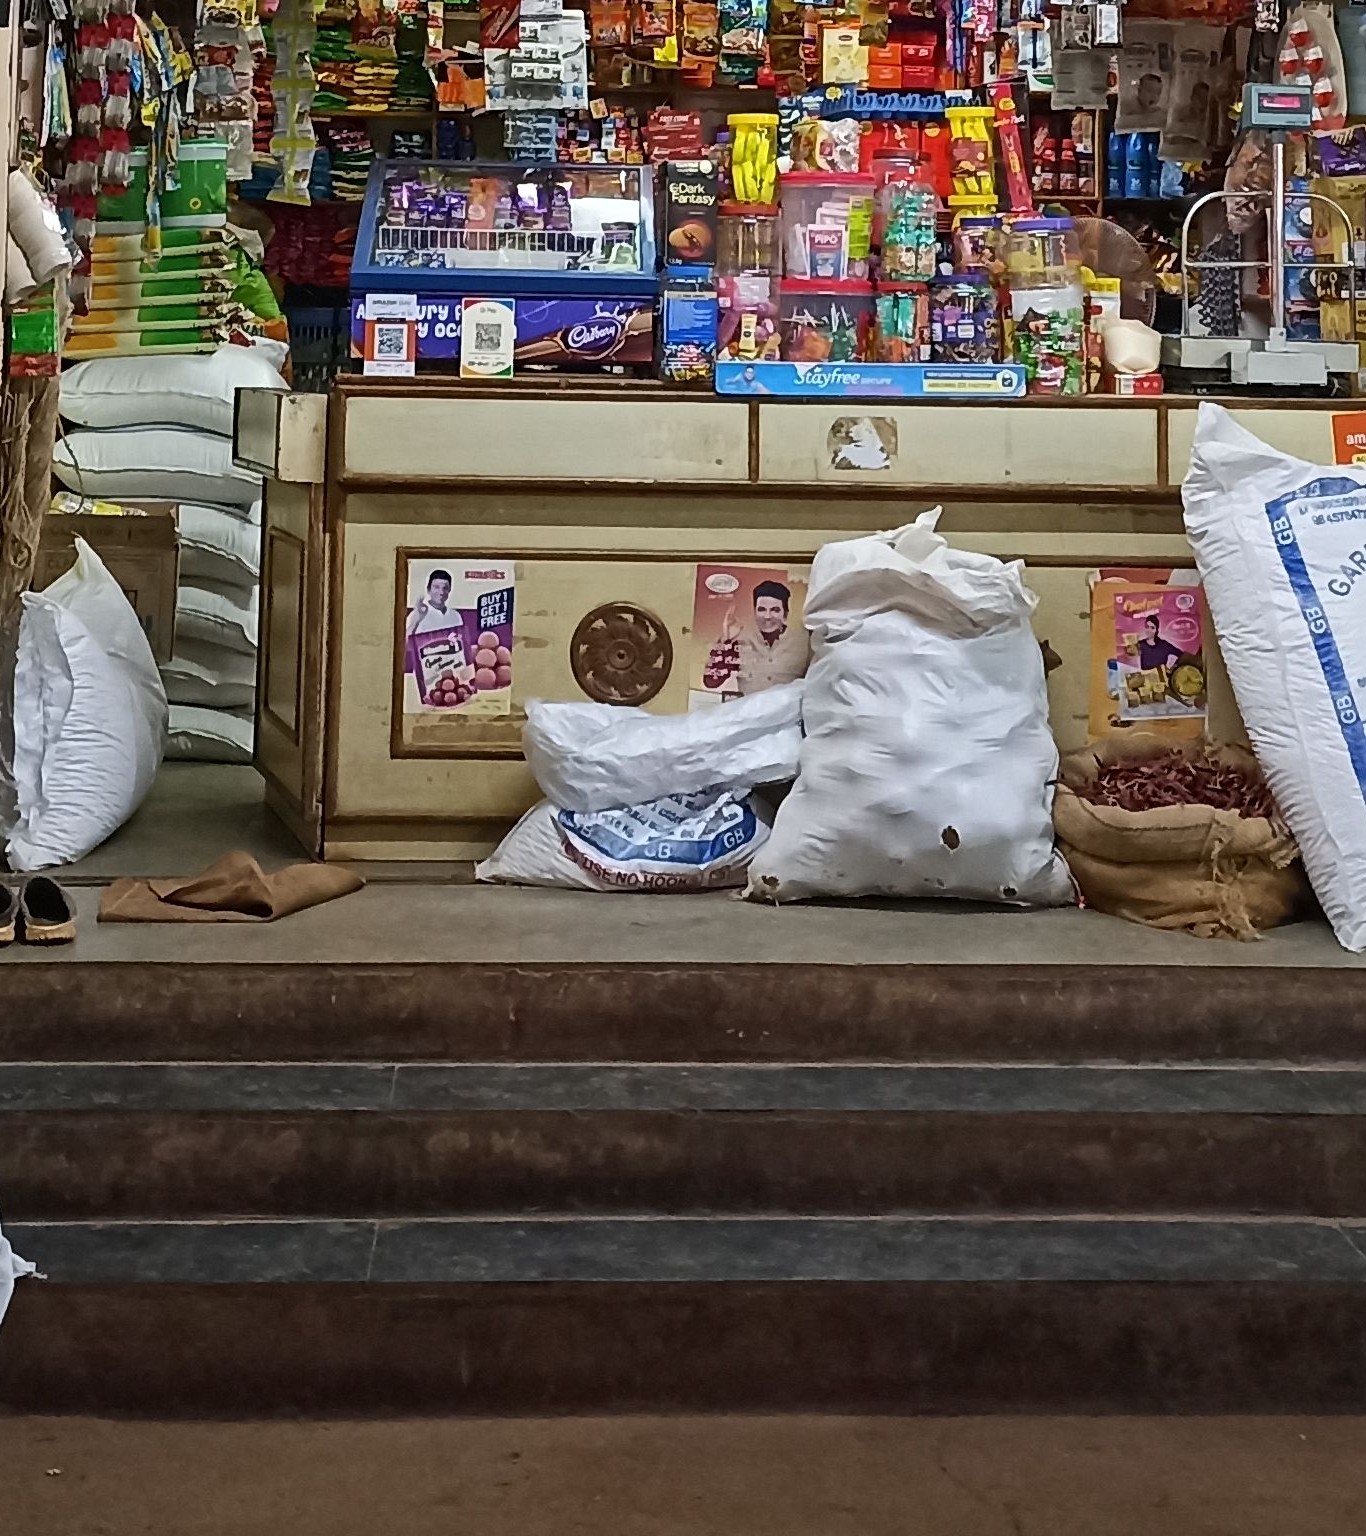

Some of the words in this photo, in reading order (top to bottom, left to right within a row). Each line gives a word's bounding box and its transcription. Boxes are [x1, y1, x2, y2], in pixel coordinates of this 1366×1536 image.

[679, 183, 705, 194] Dark
[671, 194, 716, 207] Fantasy
[567, 324, 617, 348] Cadbury
[794, 367, 861, 388] Stayfree
[480, 594, 503, 607] BUY
[480, 603, 502, 617] GET
[480, 614, 507, 629] FREE
[1336, 695, 1358, 725] GB
[723, 828, 746, 849] GB
